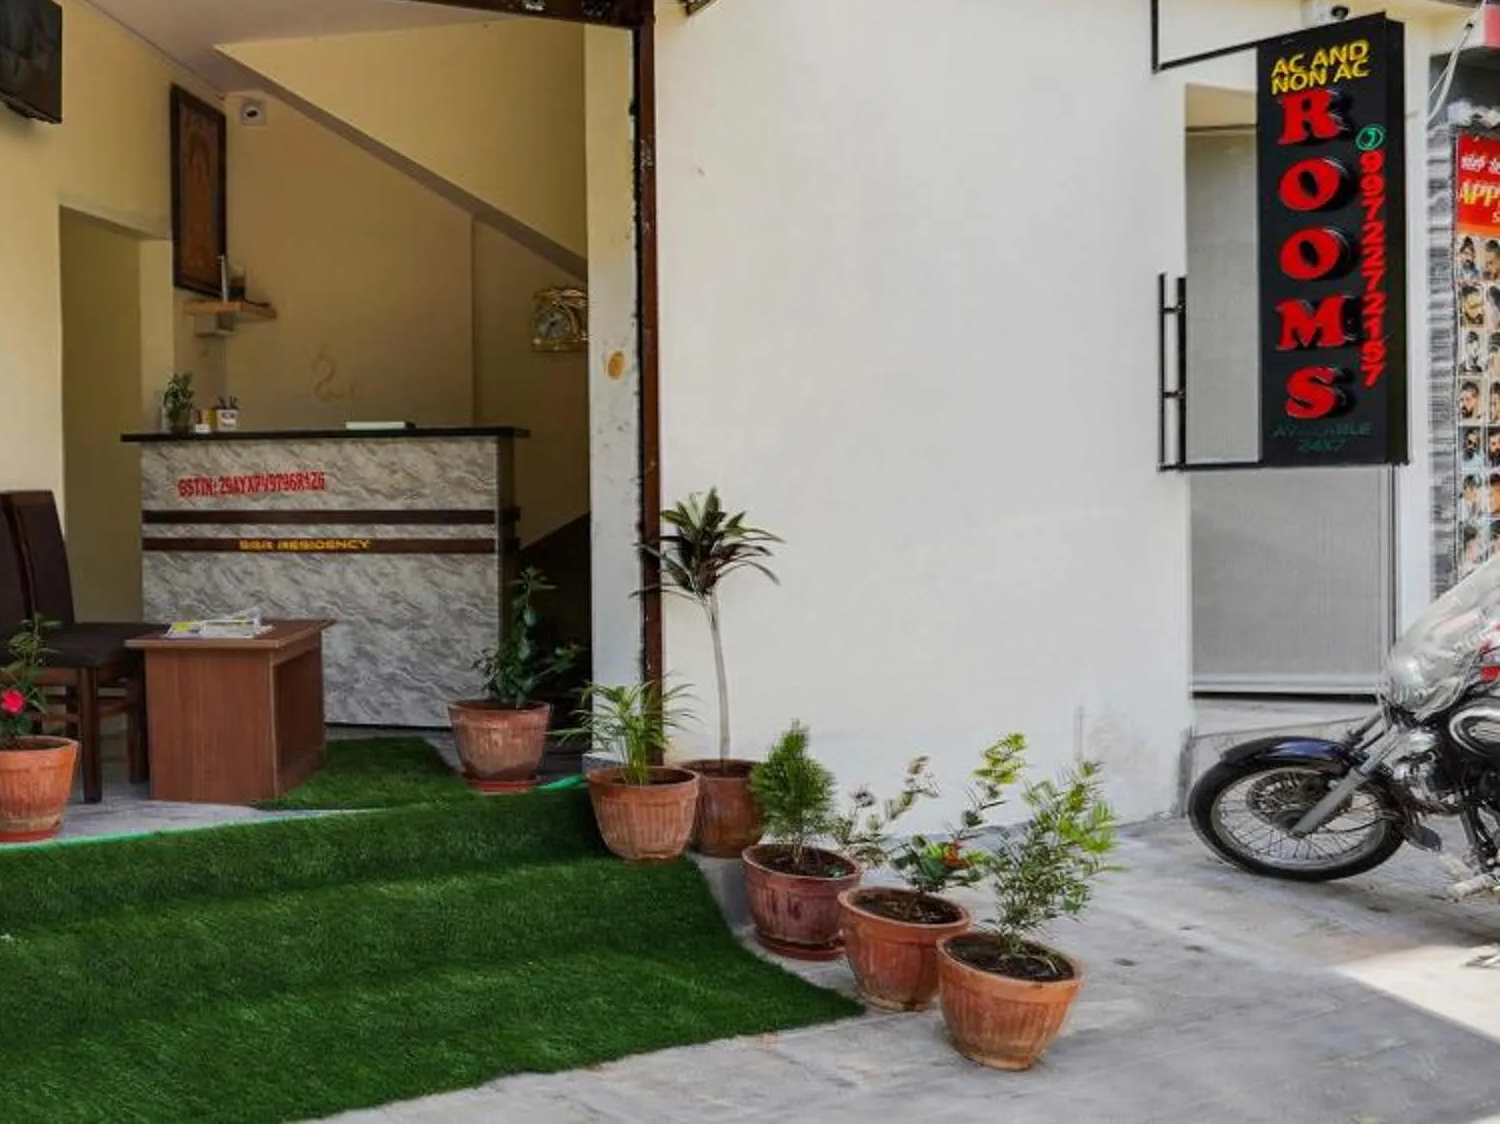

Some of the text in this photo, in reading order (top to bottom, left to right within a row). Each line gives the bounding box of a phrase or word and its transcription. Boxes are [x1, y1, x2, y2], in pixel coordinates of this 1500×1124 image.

[1272, 40, 1369, 76] AC AND
[1271, 61, 1370, 95] NON AC
[1277, 88, 1344, 419] ROOMS
